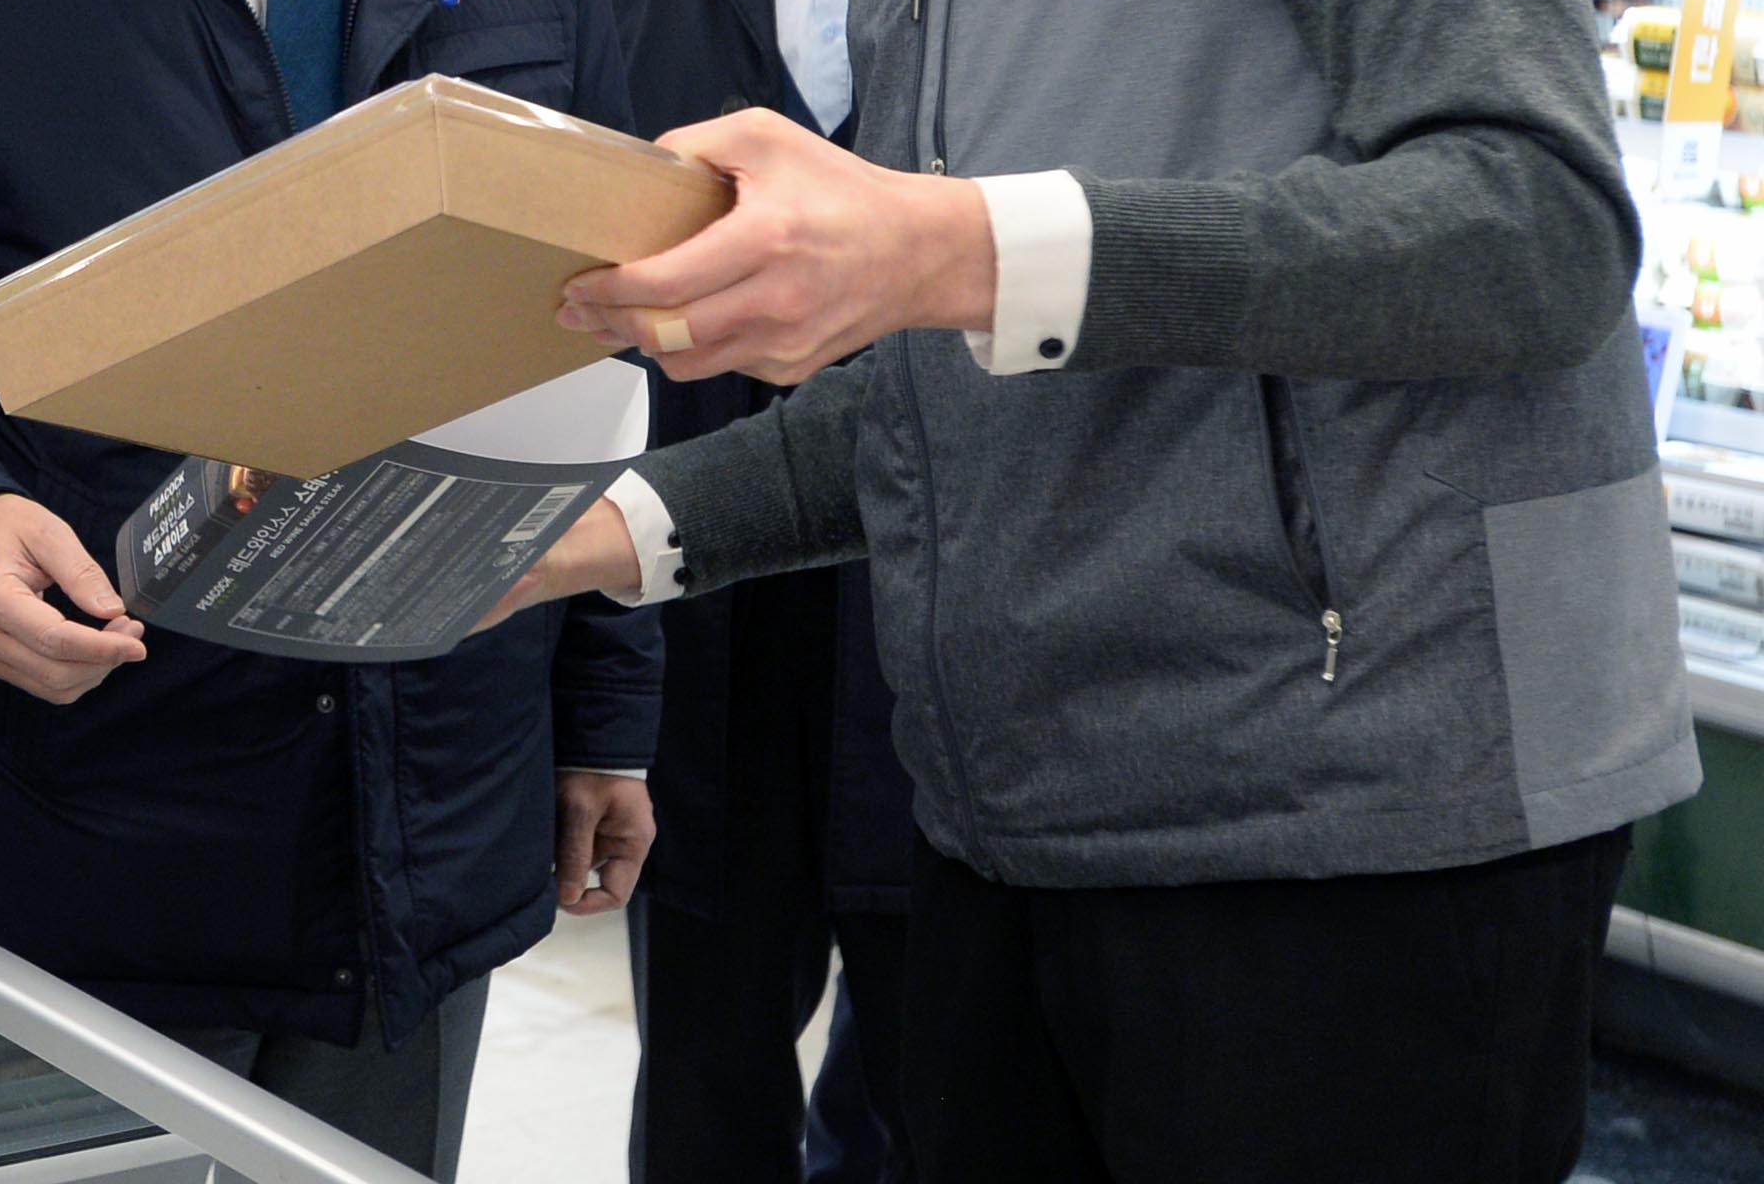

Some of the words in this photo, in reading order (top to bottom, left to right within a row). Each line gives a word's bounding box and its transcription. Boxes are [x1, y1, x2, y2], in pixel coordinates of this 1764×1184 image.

[148, 469, 186, 517] PEACOCK
[142, 493, 195, 554] 레드와인소스
[152, 518, 189, 566] 스테이크
[227, 505, 300, 573] 레드와인소스
[268, 542, 286, 559] RED
[282, 526, 303, 544] WINE
[300, 503, 324, 527] SAUCE
[320, 482, 344, 505] STEAK
[195, 574, 234, 611] PEACOCK
